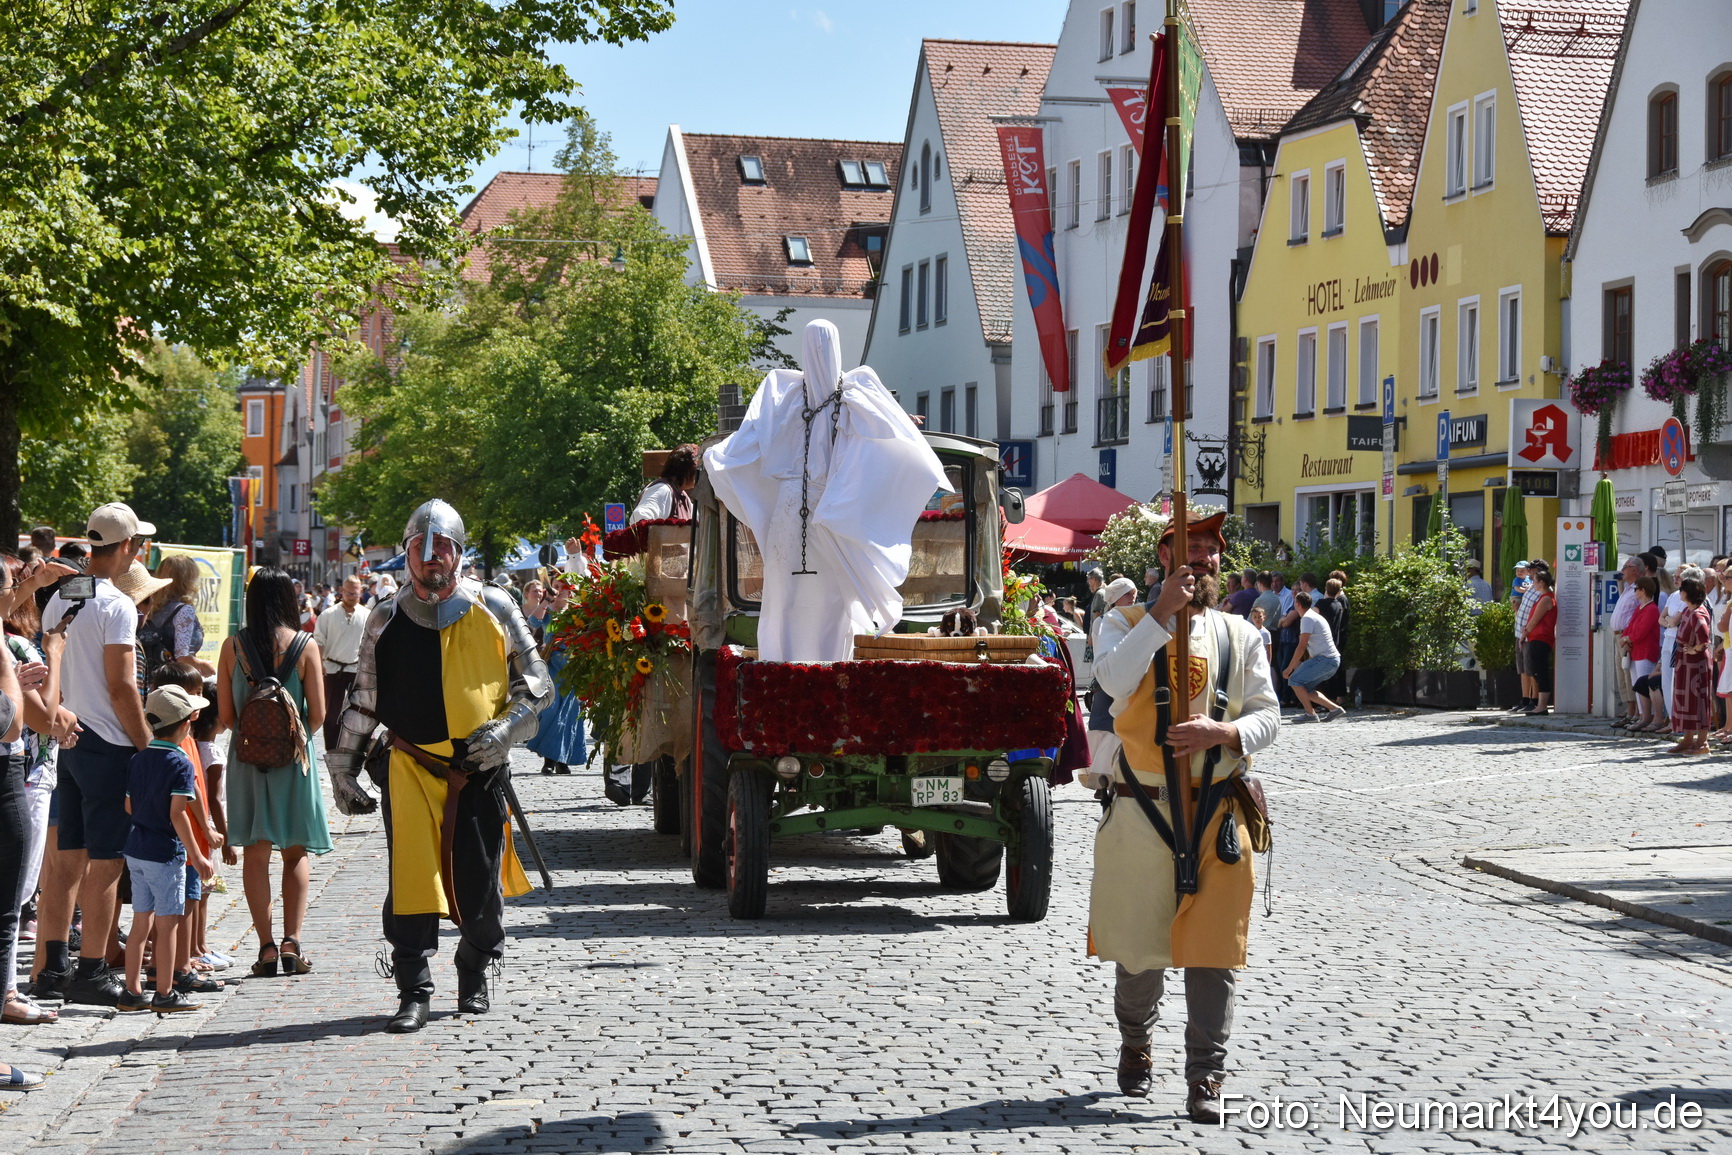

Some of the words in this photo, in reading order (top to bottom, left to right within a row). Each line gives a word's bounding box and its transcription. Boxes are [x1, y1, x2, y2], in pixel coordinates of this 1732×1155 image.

[1307, 278, 1344, 316] HOTEL
[1353, 272, 1397, 304] Lehmeier
[1439, 418, 1447, 455] P
[1301, 453, 1354, 478] Restaurant
[1616, 495, 1636, 508] POTHEKE
[607, 523, 624, 531] TAXI
[1609, 584, 1618, 600] P
[926, 778, 949, 791] NM
[917, 791, 935, 804] RP
[942, 790, 959, 802] 83
